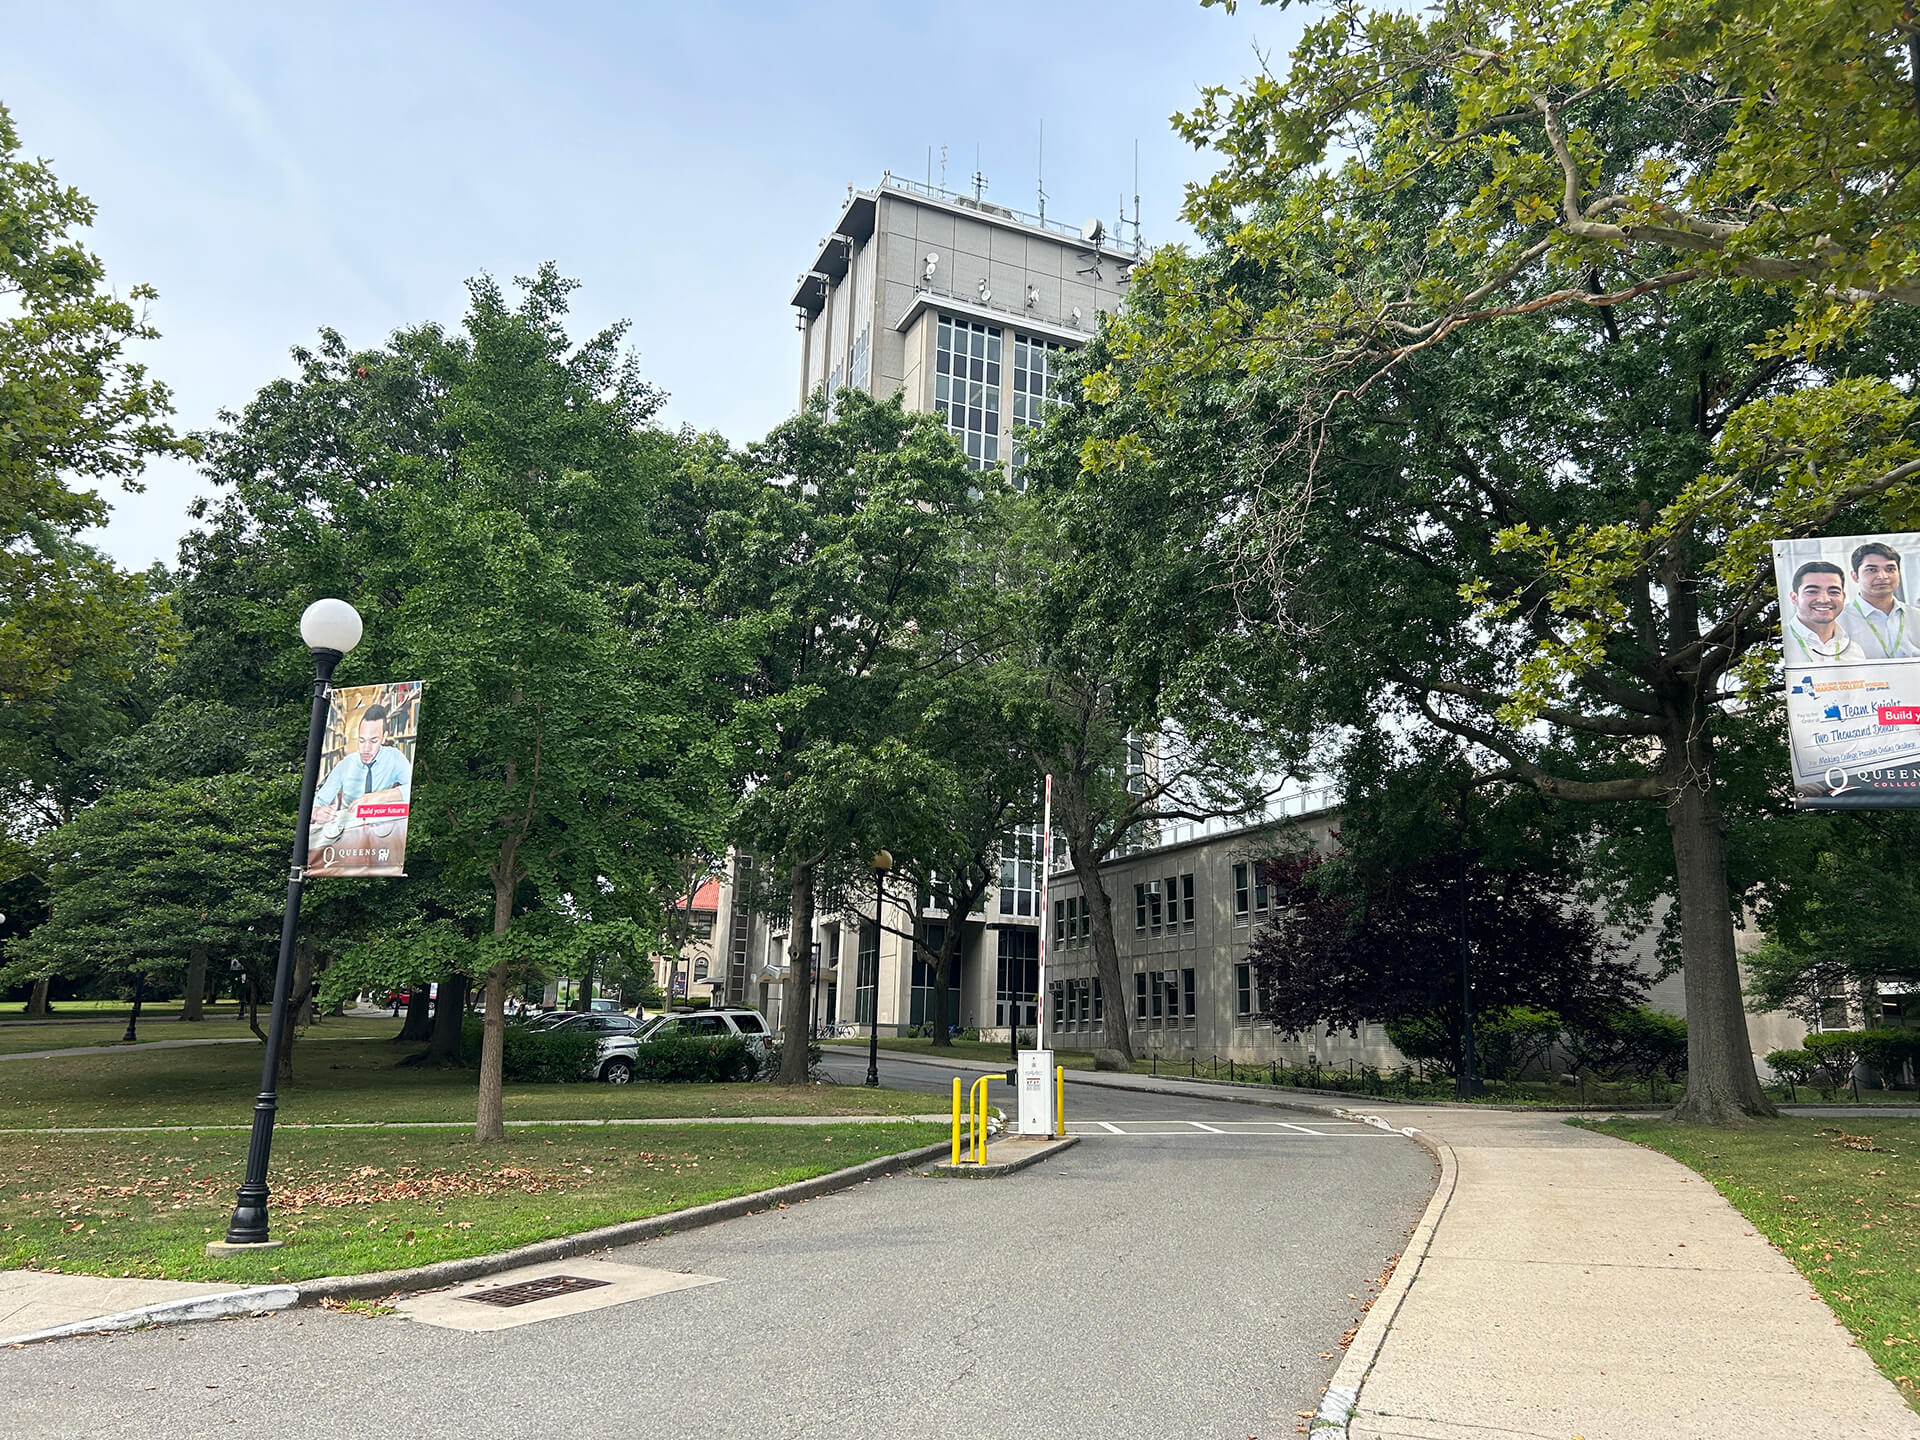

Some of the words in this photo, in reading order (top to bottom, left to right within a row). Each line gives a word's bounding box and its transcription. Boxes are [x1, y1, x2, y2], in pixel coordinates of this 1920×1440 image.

[1842, 704, 1869, 717] Team
[1885, 711, 1913, 721] Build
[1812, 733, 1829, 744] Two
[1831, 725, 1871, 741] Thousand
[338, 848, 377, 858] QUEENS
